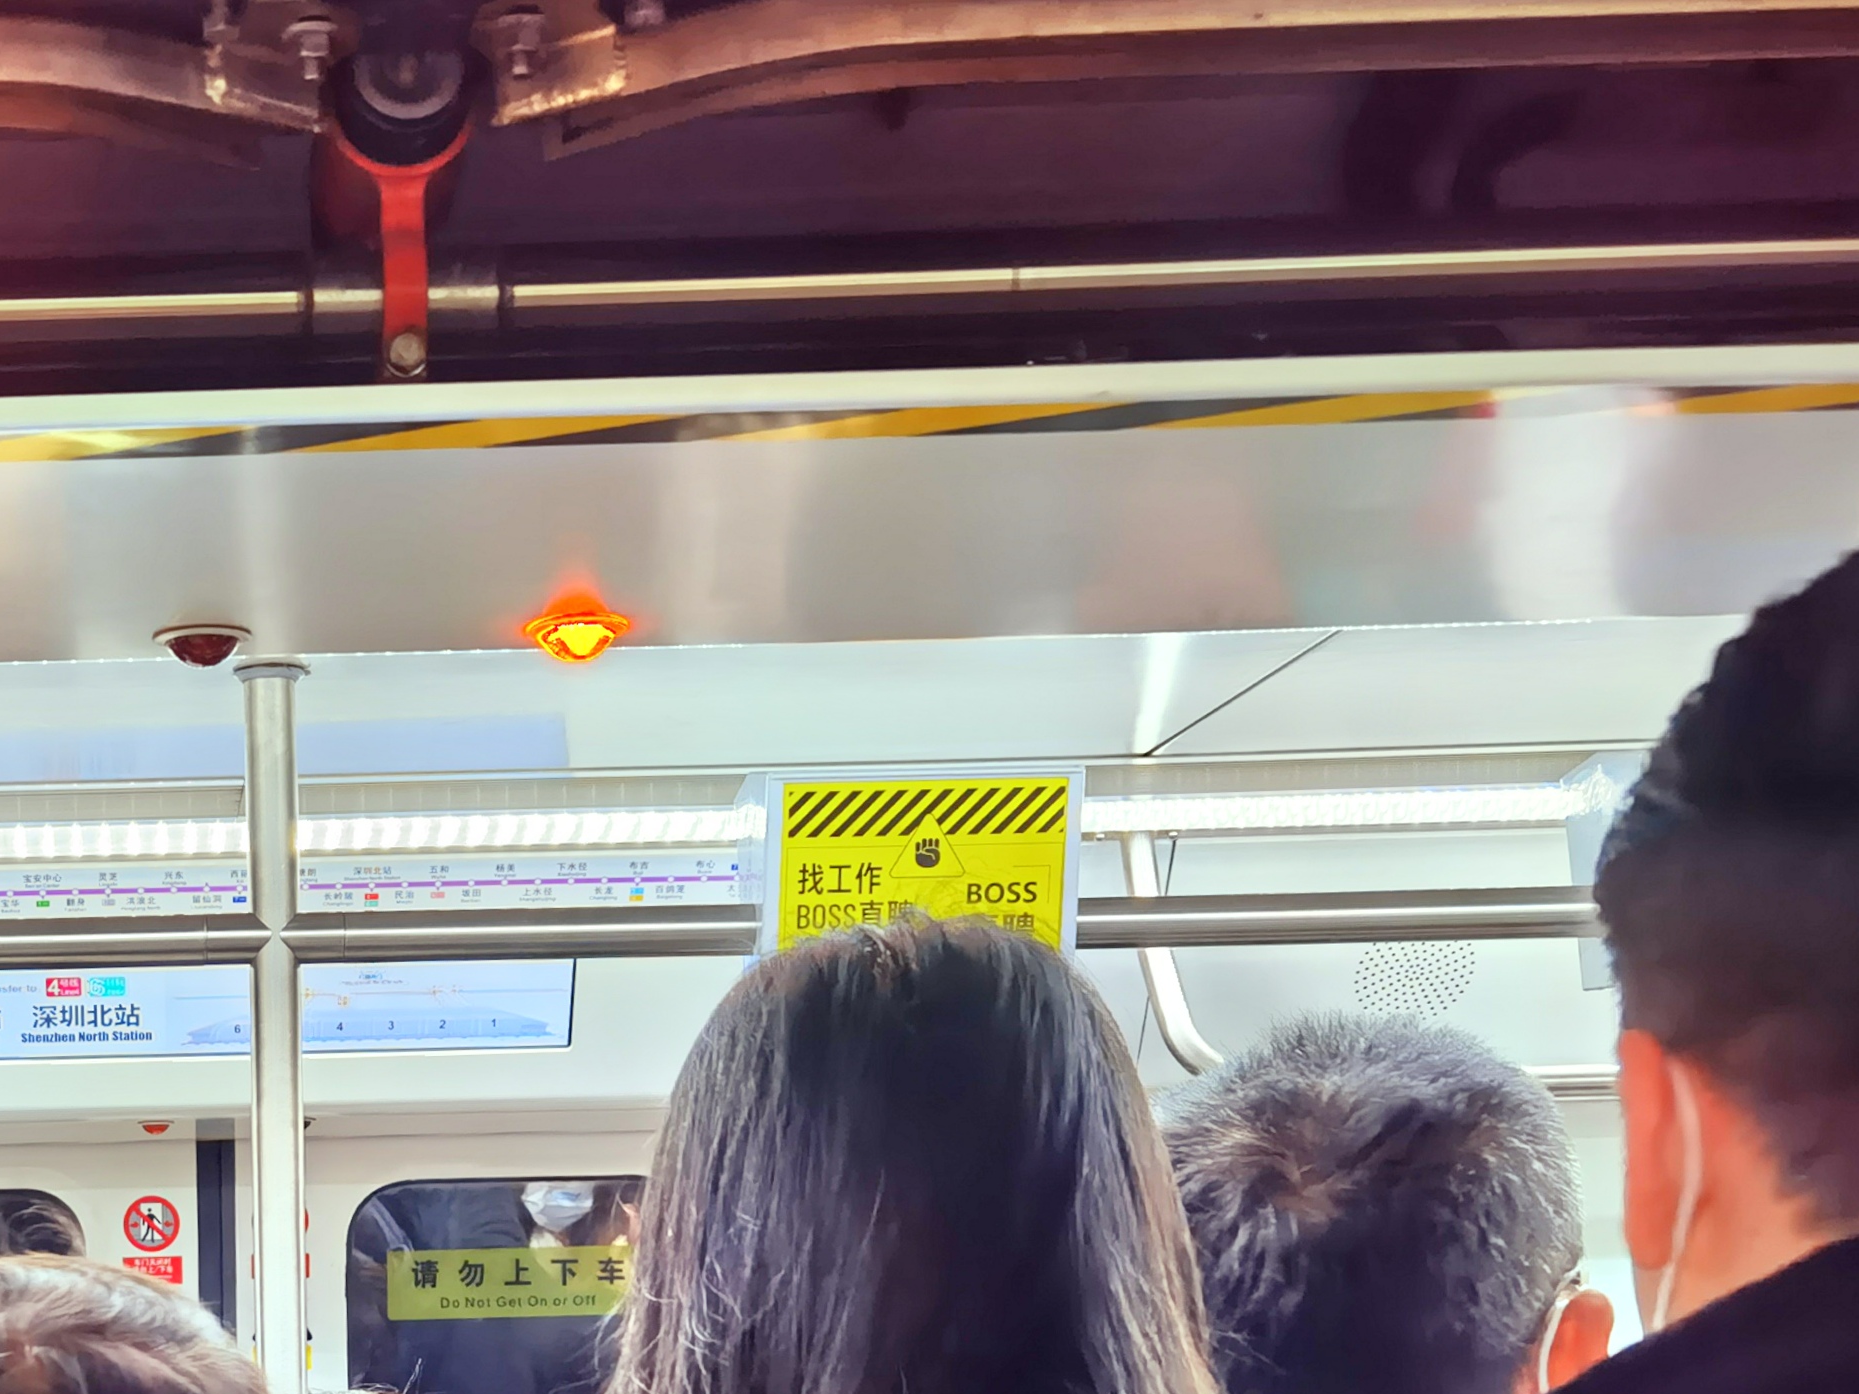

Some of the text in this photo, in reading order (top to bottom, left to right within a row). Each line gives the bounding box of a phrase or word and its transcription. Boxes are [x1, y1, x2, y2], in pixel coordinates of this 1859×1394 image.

[797, 862, 883, 895] 找工作
[966, 881, 1038, 905] BOSS
[26, 985, 38, 993] to
[47, 979, 61, 996] 4
[32, 1003, 141, 1029] 深圳北站
[336, 1022, 343, 1031] 4
[388, 1021, 394, 1030] 3
[439, 1020, 446, 1029] 2
[21, 1030, 153, 1043] Shenzhen North Station
[411, 1256, 626, 1289] 请勿上下车
[440, 1294, 596, 1309] Do Not Get On or Off
